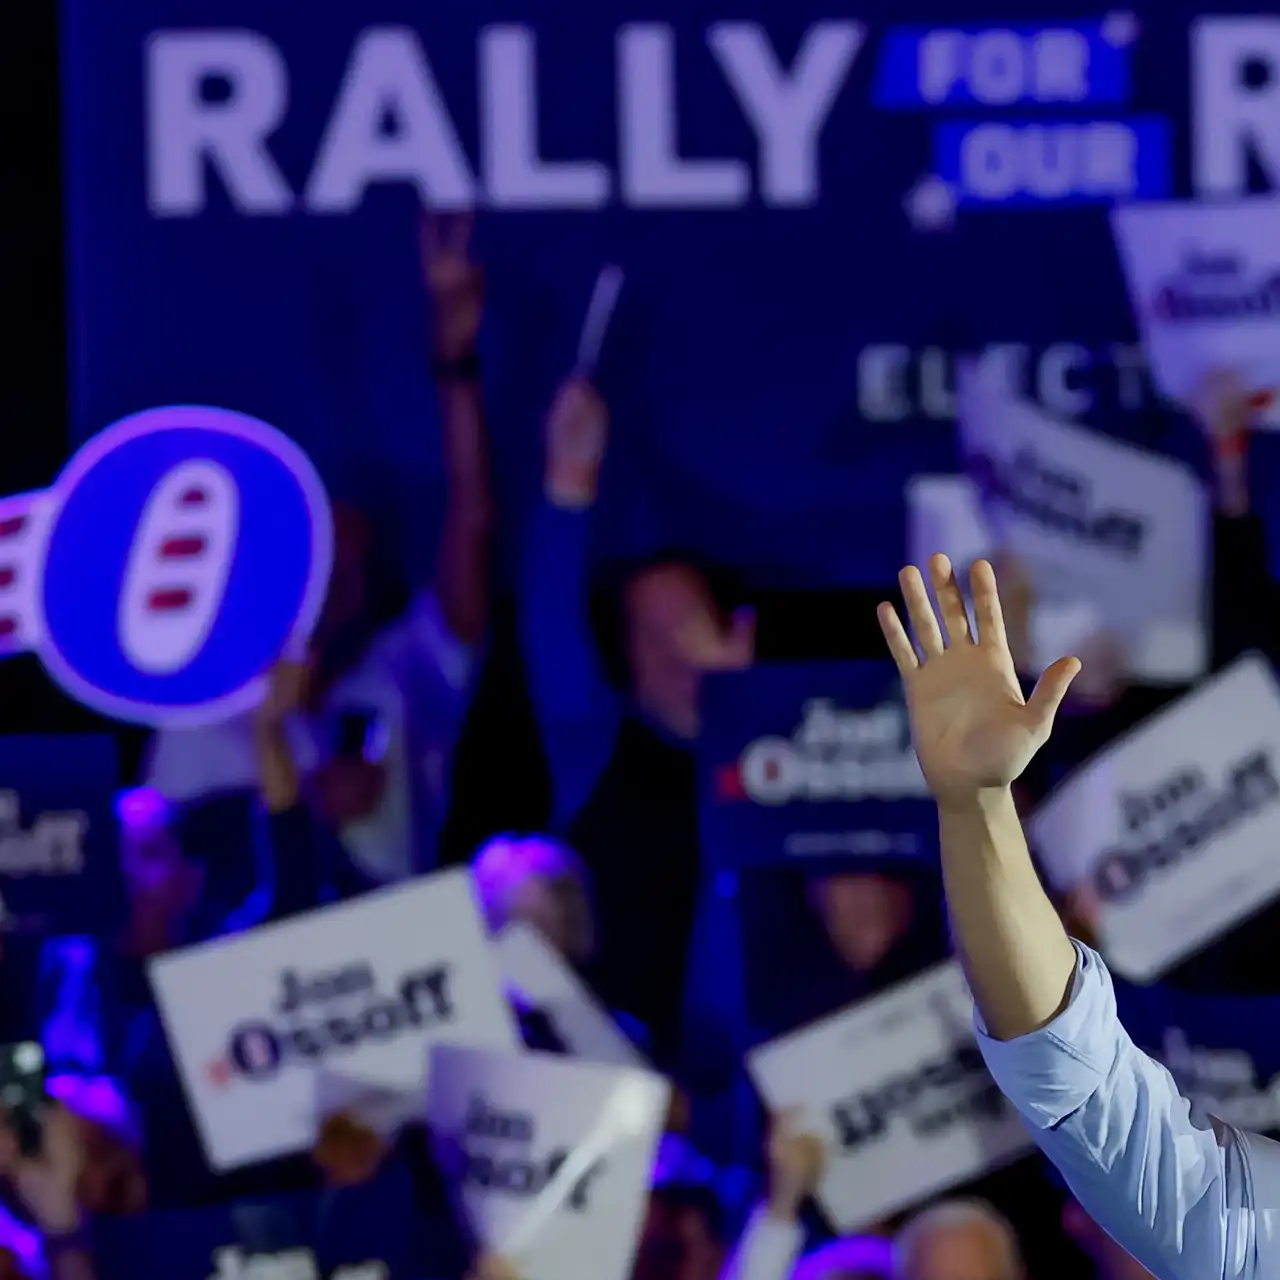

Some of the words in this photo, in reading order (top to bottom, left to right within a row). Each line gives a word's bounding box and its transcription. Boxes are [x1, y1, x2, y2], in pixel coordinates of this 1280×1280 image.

[916, 29, 1092, 104] FOR
[146, 22, 864, 216] RALLY
[958, 120, 1139, 200] OUR
